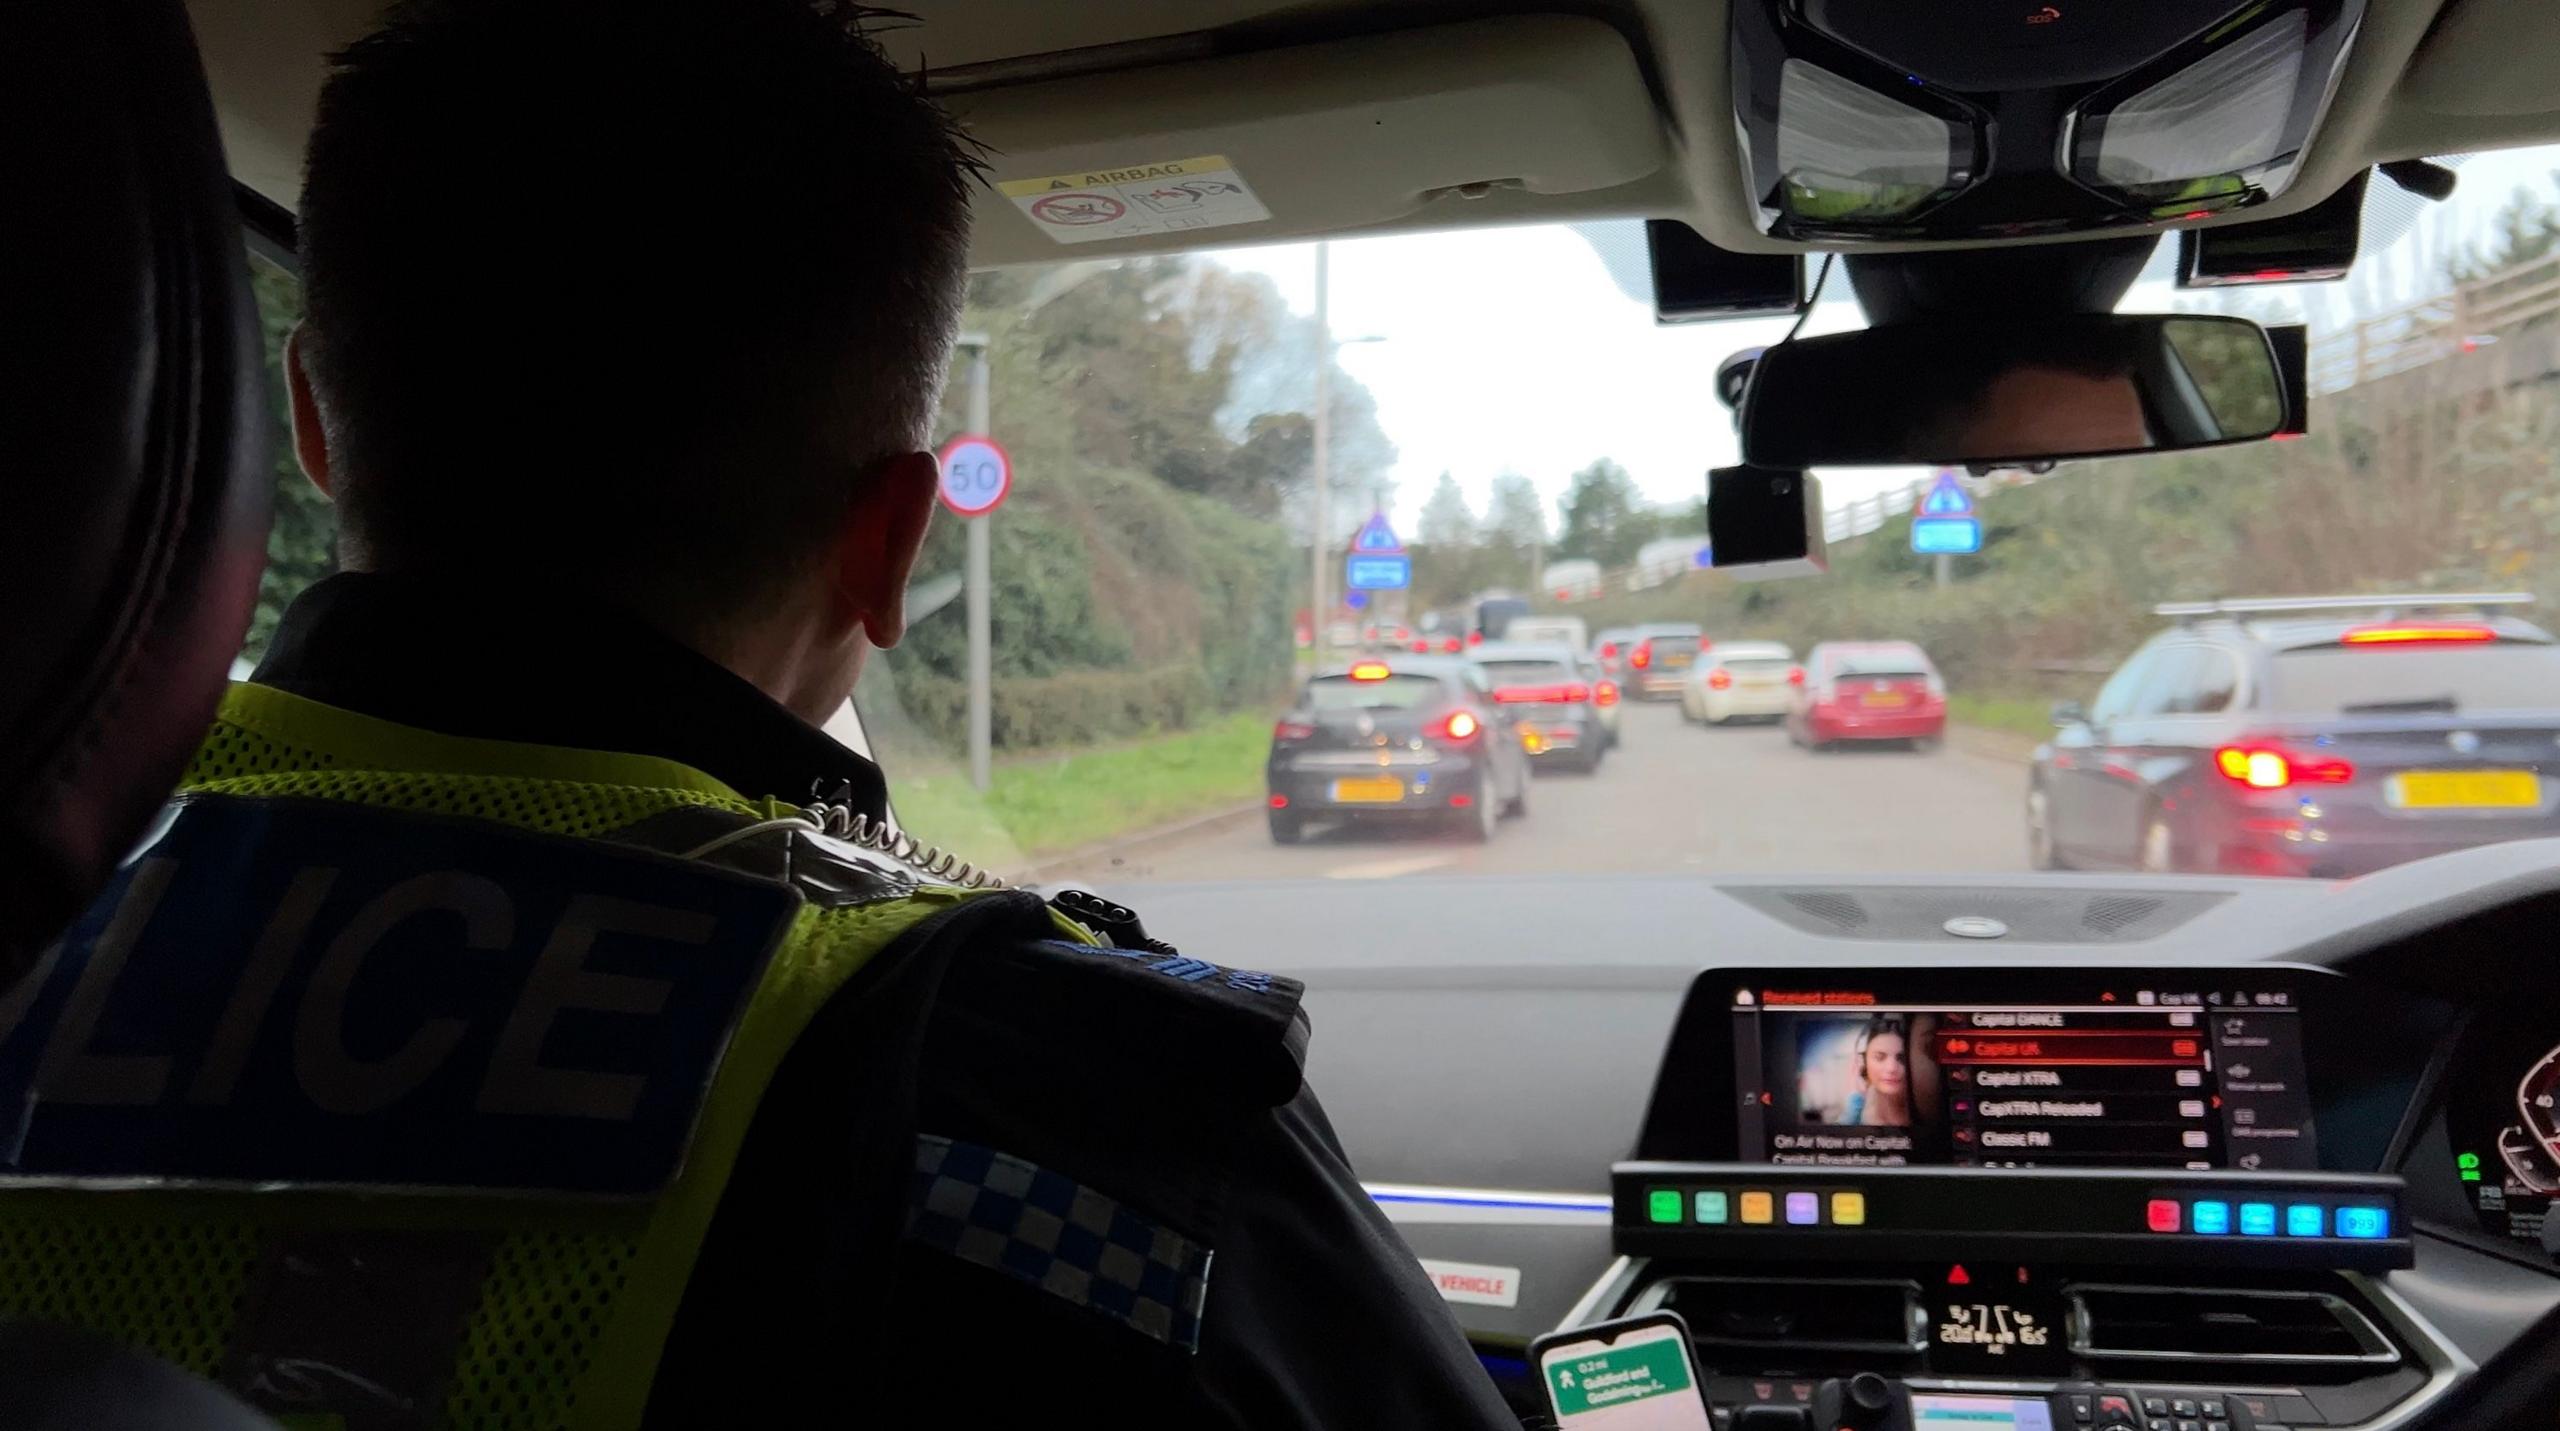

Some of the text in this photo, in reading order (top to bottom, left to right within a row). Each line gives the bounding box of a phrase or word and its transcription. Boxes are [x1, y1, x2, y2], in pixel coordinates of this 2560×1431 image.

[2026, 15, 2050, 25] SOS
[1084, 164, 1183, 186] AIRBAG
[952, 462, 997, 492] 50
[0, 856, 720, 1121] LICE
[1973, 1013, 2063, 1028] Capital DANCE
[1975, 1042, 2018, 1056] Capital
[1977, 1071, 2061, 1087] Capital XTRA
[2041, 1101, 2103, 1116] Reloaded
[1775, 1135, 1794, 1148] On
[1796, 1135, 1813, 1148] Air
[1816, 1135, 1843, 1148] Now
[1845, 1137, 1863, 1148] on
[1982, 1131, 2050, 1146] Classic FM
[1818, 1153, 1876, 1165] Breakfast
[2348, 1217, 2377, 1231] 999
[1440, 1274, 1504, 1295] VEHICLE
